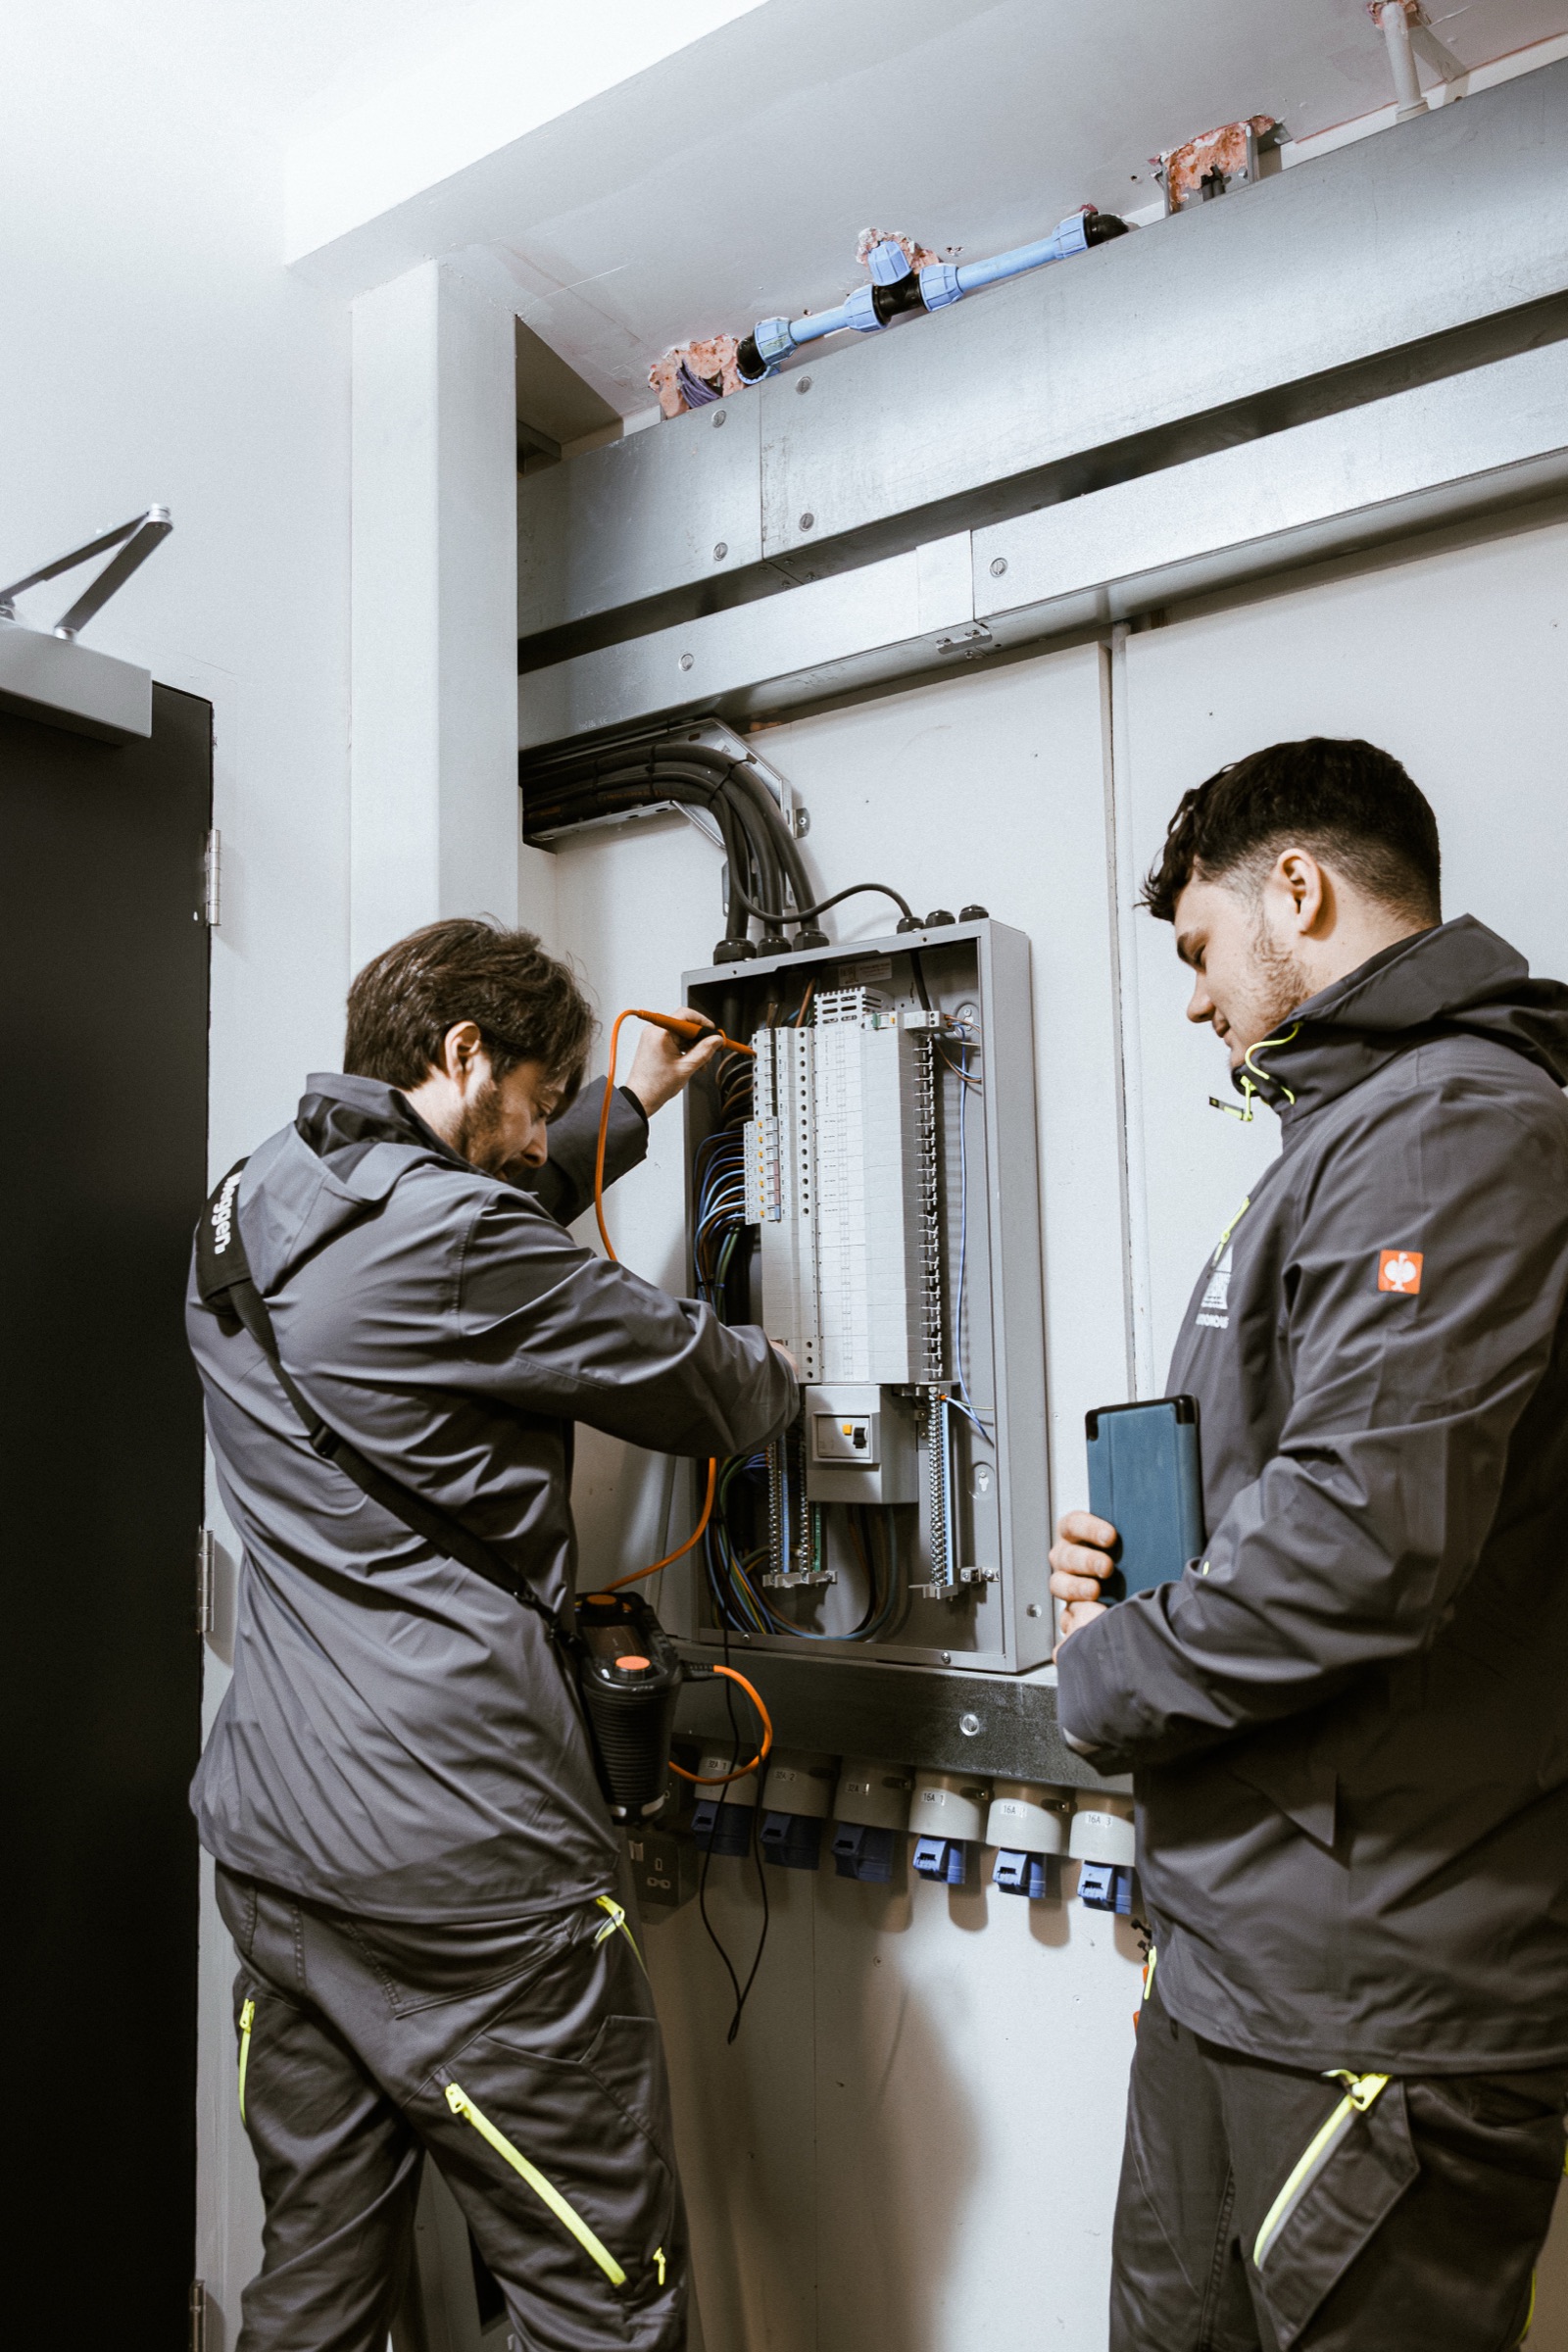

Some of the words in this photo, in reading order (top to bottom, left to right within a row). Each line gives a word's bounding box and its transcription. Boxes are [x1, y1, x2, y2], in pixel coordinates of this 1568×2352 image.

[790, 1773, 796, 1782] 2
[923, 1793, 936, 1802] 16A
[1004, 1805, 1016, 1814] 16A
[1088, 1814, 1102, 1824] 16A
